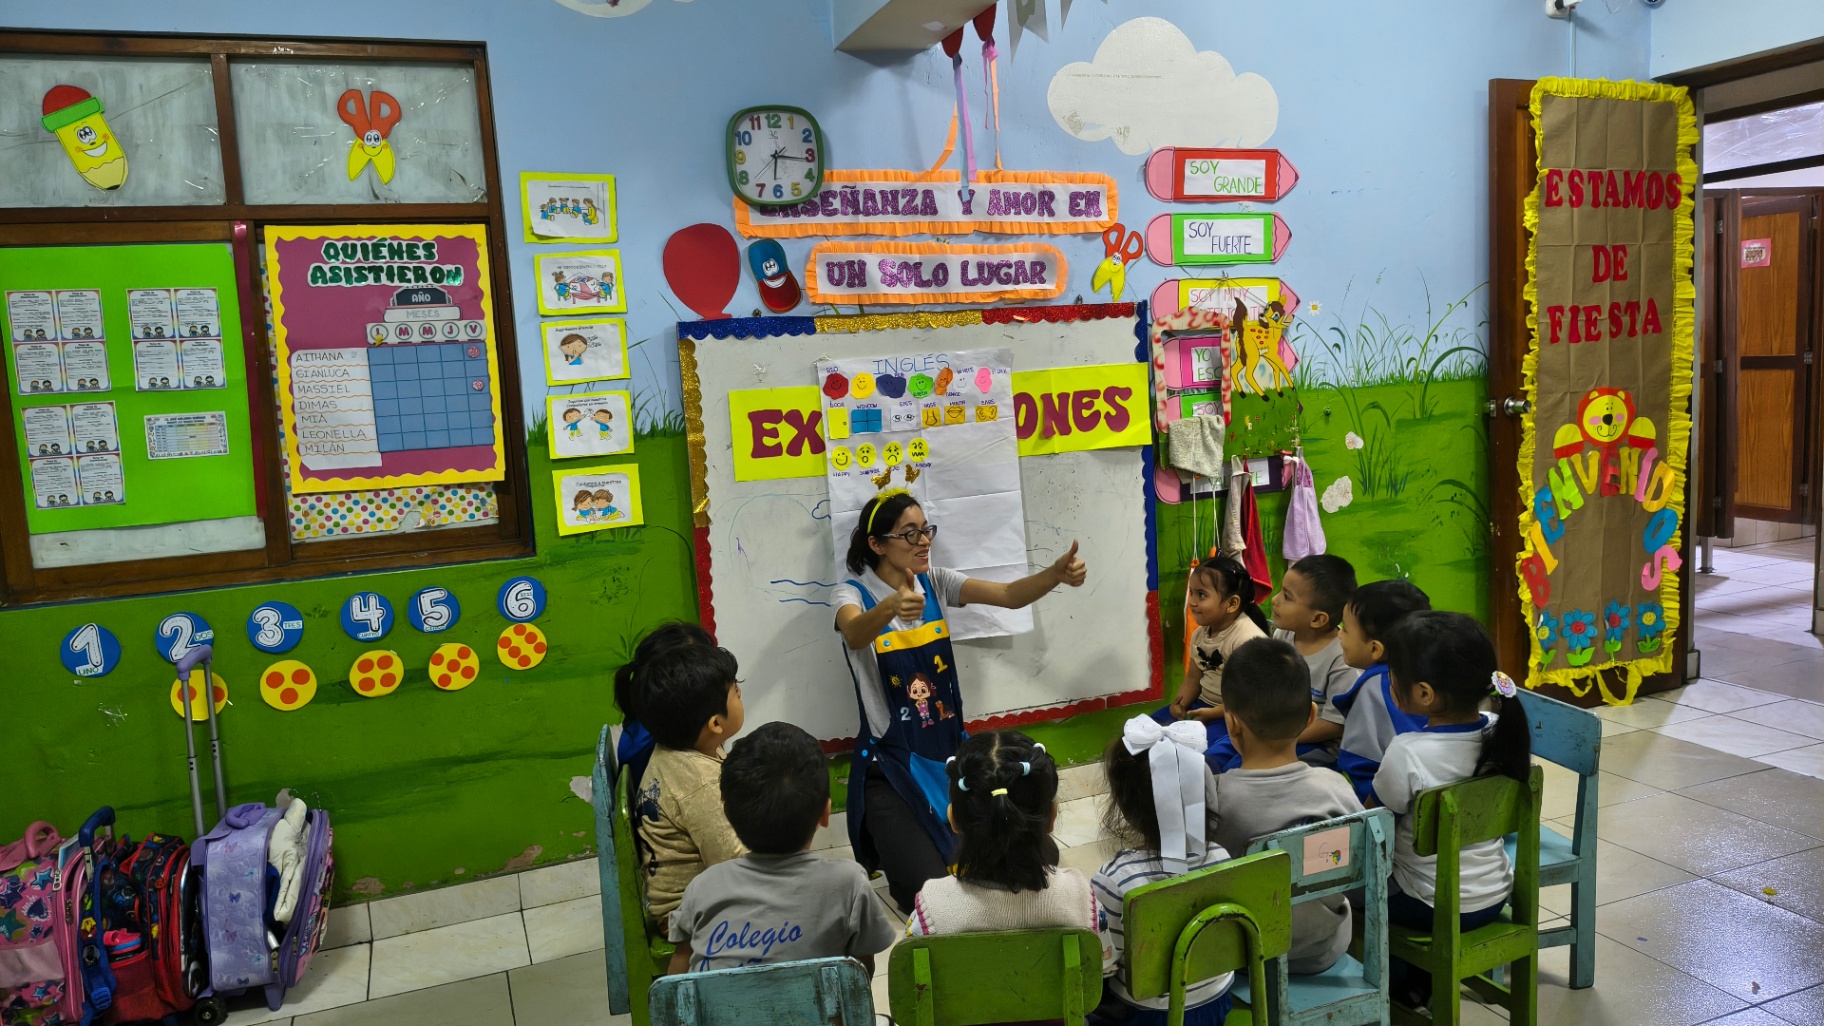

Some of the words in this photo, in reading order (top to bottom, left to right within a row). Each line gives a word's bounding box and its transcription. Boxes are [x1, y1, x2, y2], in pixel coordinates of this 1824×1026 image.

[749, 115, 761, 130] 11
[765, 113, 782, 128] 12
[787, 114, 794, 129] 1
[735, 130, 752, 146] 10
[802, 128, 813, 143] 2
[735, 149, 746, 165] 9
[805, 148, 816, 163] 3
[804, 168, 815, 182] 4
[1190, 160, 1220, 175] SOY
[739, 170, 750, 185] 8
[1213, 176, 1264, 194] GRANDE
[756, 183, 766, 198] 7
[773, 184, 784, 199] 6
[791, 182, 802, 197] 5
[1544, 169, 1682, 210] ESTAMOS
[959, 189, 976, 215] Y
[987, 189, 1057, 217] AMOR
[1069, 190, 1103, 217] EN
[1188, 221, 1214, 238] SOY
[322, 237, 437, 262] QUIÉNES
[1211, 235, 1252, 255] FUERTE
[1592, 244, 1628, 283] DE
[309, 264, 463, 286] ASISTIERON
[826, 259, 867, 288] UN
[878, 259, 949, 288] SOLO
[960, 259, 1047, 287] LUGAR
[411, 292, 431, 303] AÑO
[1190, 289, 1215, 303] SOY
[1223, 287, 1250, 302] MUY
[406, 309, 440, 319] MESES
[1547, 298, 1663, 345] FIESTA
[398, 326, 410, 336] M
[422, 326, 434, 336] M
[447, 325, 454, 335] J
[469, 324, 478, 334] V
[295, 351, 344, 362] AITHANA
[1195, 349, 1212, 363] YO
[872, 353, 951, 375] INGLÉS
[295, 368, 350, 378] GIANLUCA
[297, 384, 351, 394] MASSIEL
[298, 401, 338, 410] DIMAS
[301, 414, 328, 424] MIA
[303, 429, 367, 439] LEONELLA
[1522, 444, 1683, 609] BIENVENIDOS
[418, 588, 451, 627] 5
[504, 581, 536, 619] 6
[351, 594, 386, 632] 4
[253, 607, 284, 647] 3
[284, 621, 302, 629] TRES
[160, 614, 202, 662] 2
[194, 630, 214, 641] DOS
[70, 623, 103, 667] 1
[78, 666, 100, 677] UNO
[934, 655, 948, 674] 1
[900, 707, 911, 721] 2
[706, 921, 803, 956] Colegio
